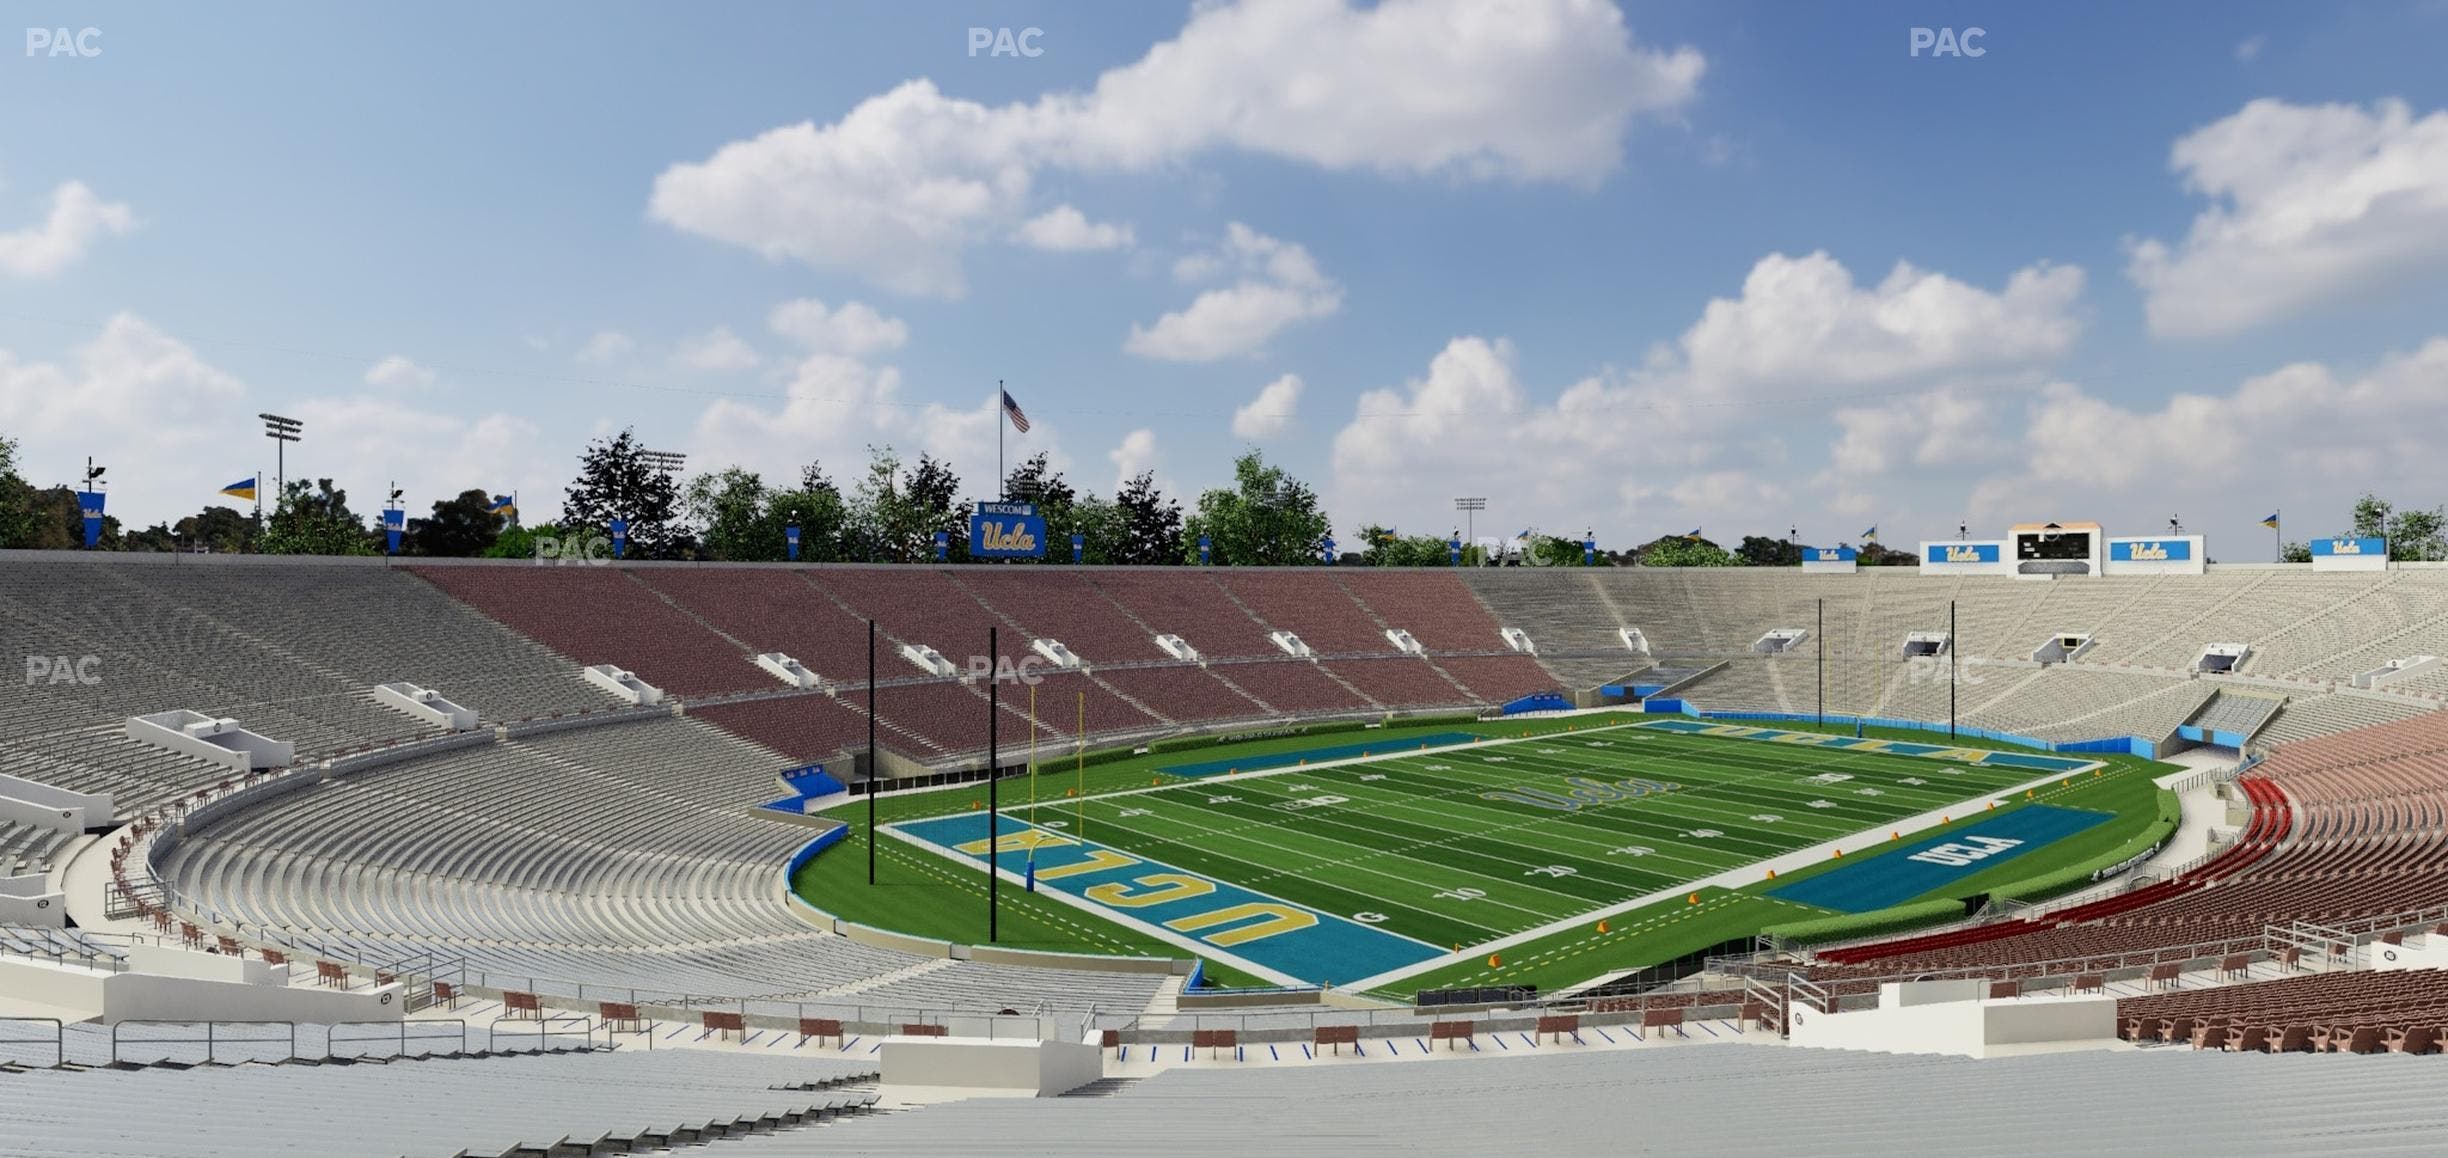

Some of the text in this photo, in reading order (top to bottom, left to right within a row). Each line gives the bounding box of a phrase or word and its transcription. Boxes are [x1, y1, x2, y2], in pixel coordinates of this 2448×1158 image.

[984, 504, 1022, 514] WESCOM
[981, 521, 1036, 551] Ucla
[1906, 835, 2025, 867] UCLA
[1352, 911, 1391, 924] G
